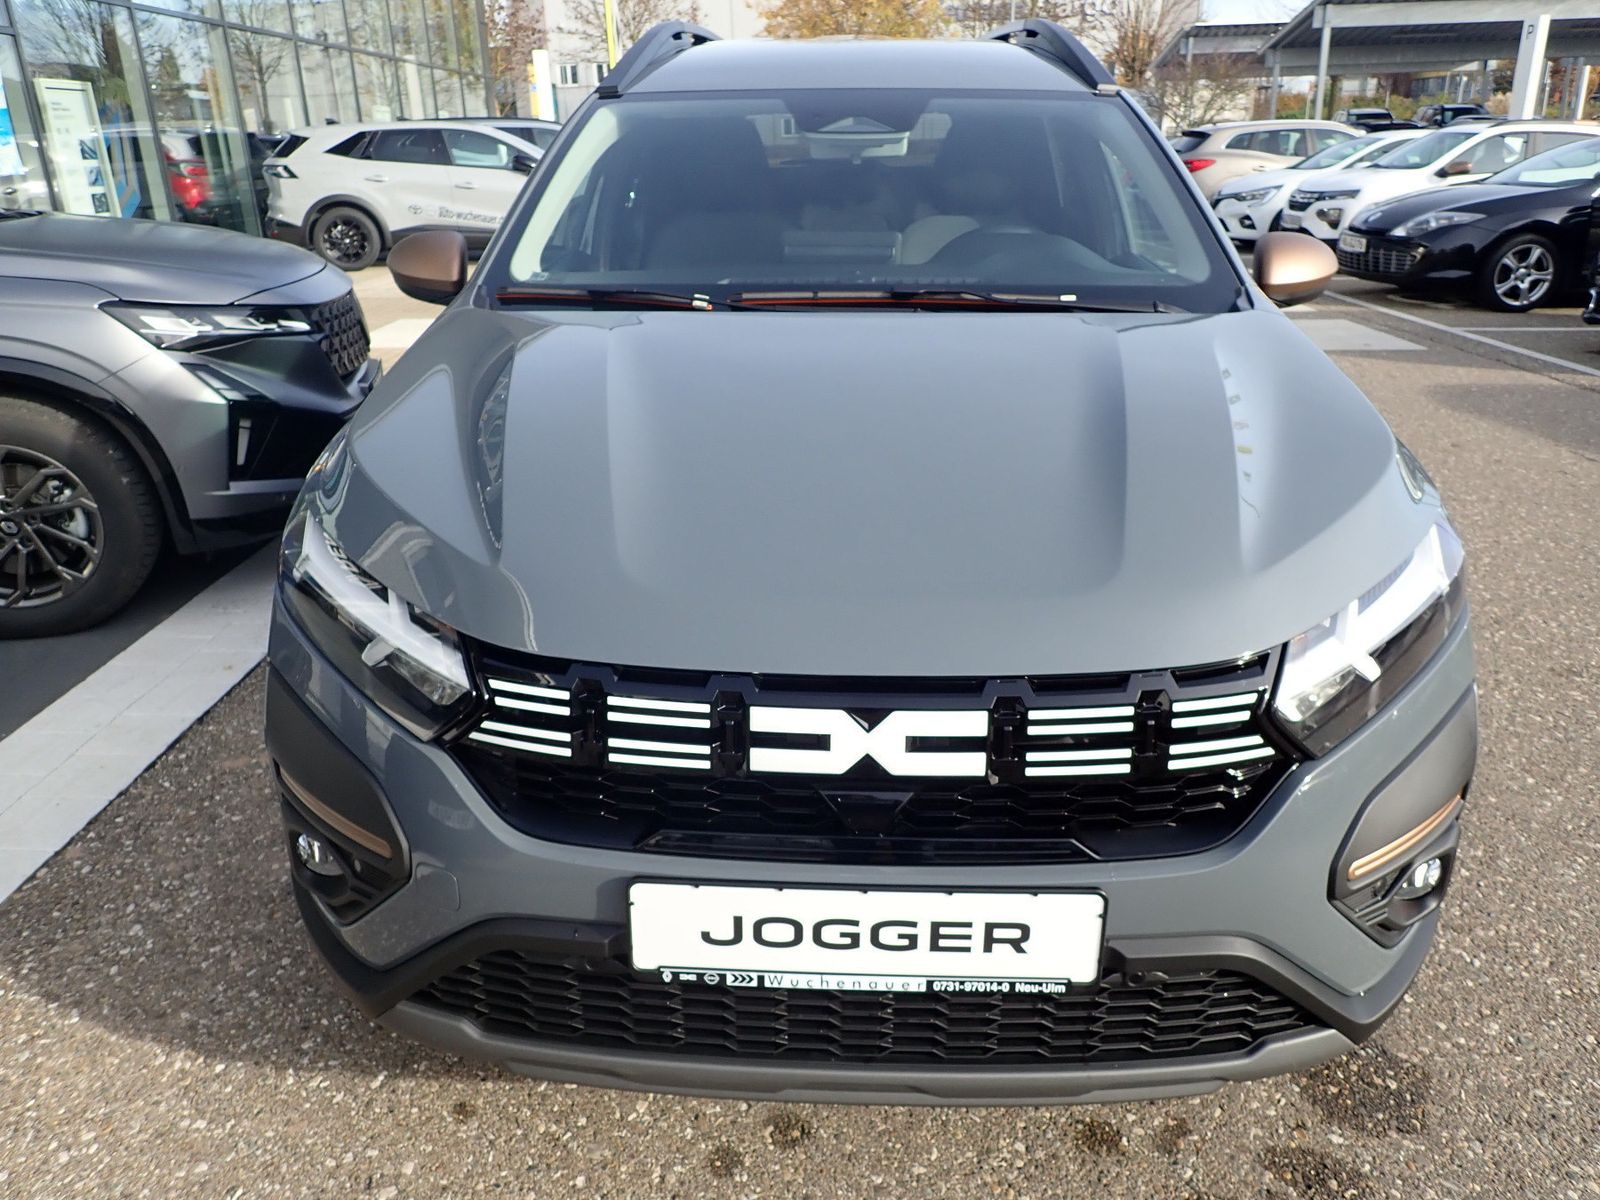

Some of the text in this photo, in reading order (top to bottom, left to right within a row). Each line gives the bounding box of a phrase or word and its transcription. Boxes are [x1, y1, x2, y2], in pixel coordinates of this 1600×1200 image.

[701, 915, 1031, 955] JOGGER
[767, 975, 924, 991] Wuchenauer
[1015, 982, 1066, 993] Neu-Ulm
